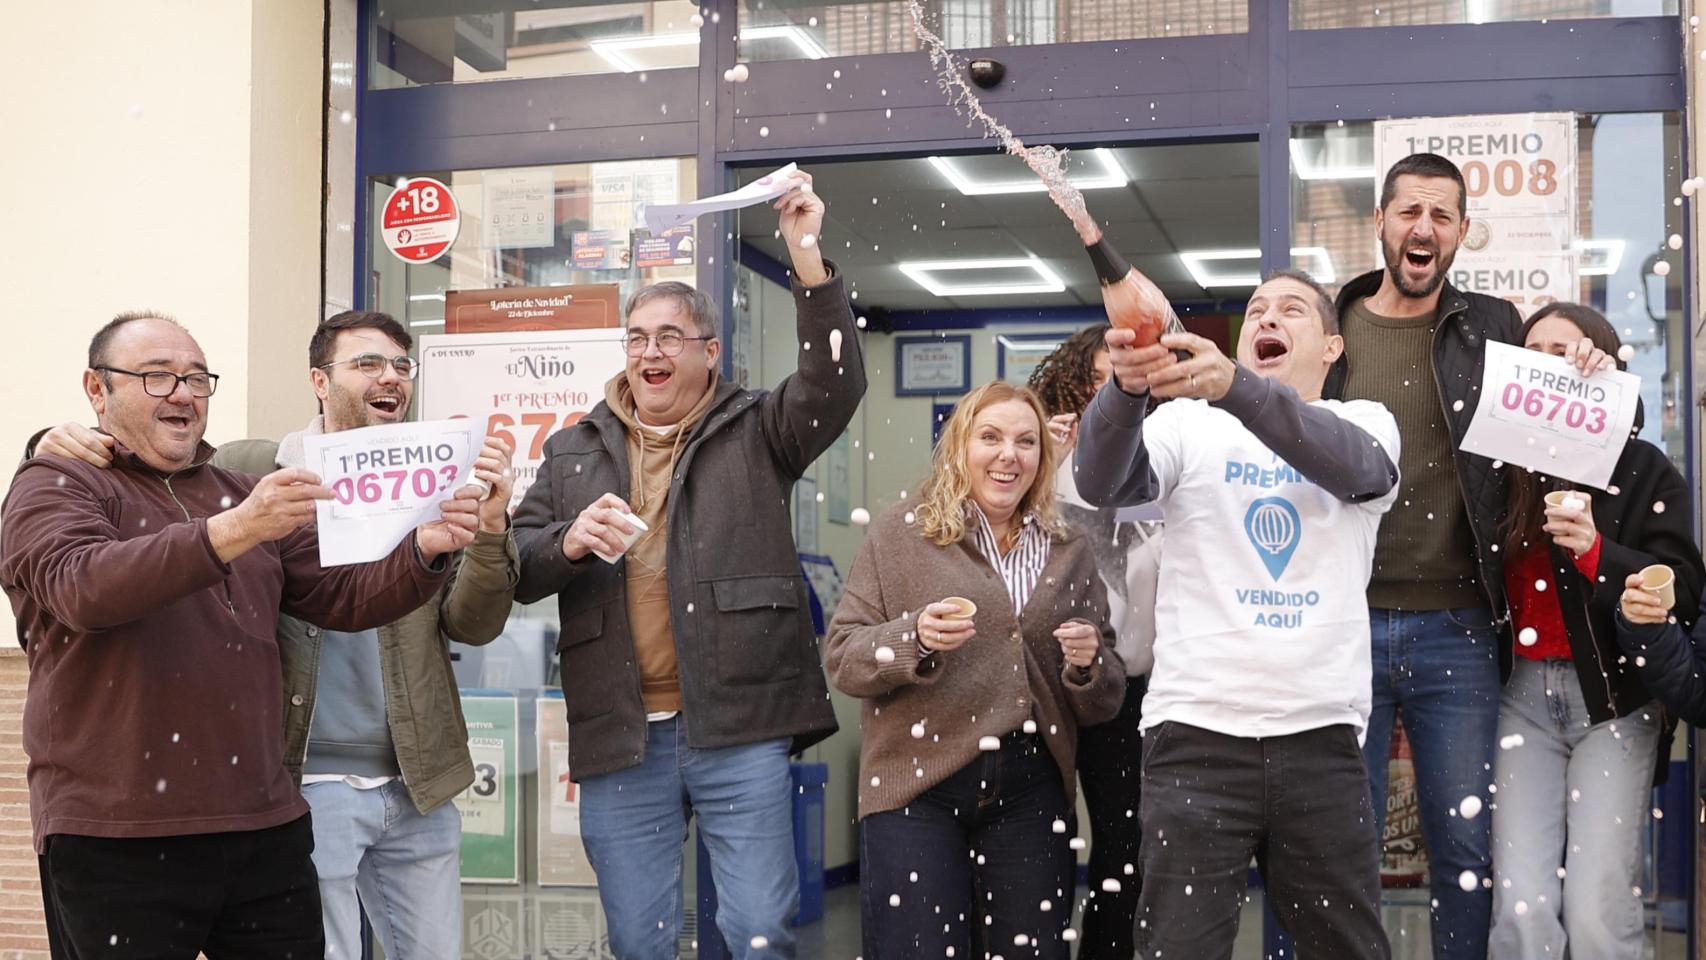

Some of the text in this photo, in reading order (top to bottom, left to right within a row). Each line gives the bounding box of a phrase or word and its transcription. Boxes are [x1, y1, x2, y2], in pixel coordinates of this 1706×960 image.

[1427, 132, 1543, 156] PREMIO
[601, 183, 625, 193] VISA
[396, 186, 440, 216] +18
[1446, 269, 1549, 290] REMIO
[523, 299, 533, 309] de
[534, 294, 573, 308] Navidad
[507, 310, 516, 318] 22
[517, 355, 575, 380] Niño
[1528, 368, 1606, 403] PREMIO
[513, 388, 589, 410] PREMIO
[1501, 382, 1607, 434] 06703
[355, 443, 454, 471] PREMIO
[1224, 460, 1316, 489] PREMI
[1235, 588, 1320, 607] VENDIDO
[1253, 610, 1303, 629] AQUÍ
[472, 763, 497, 797] 3
